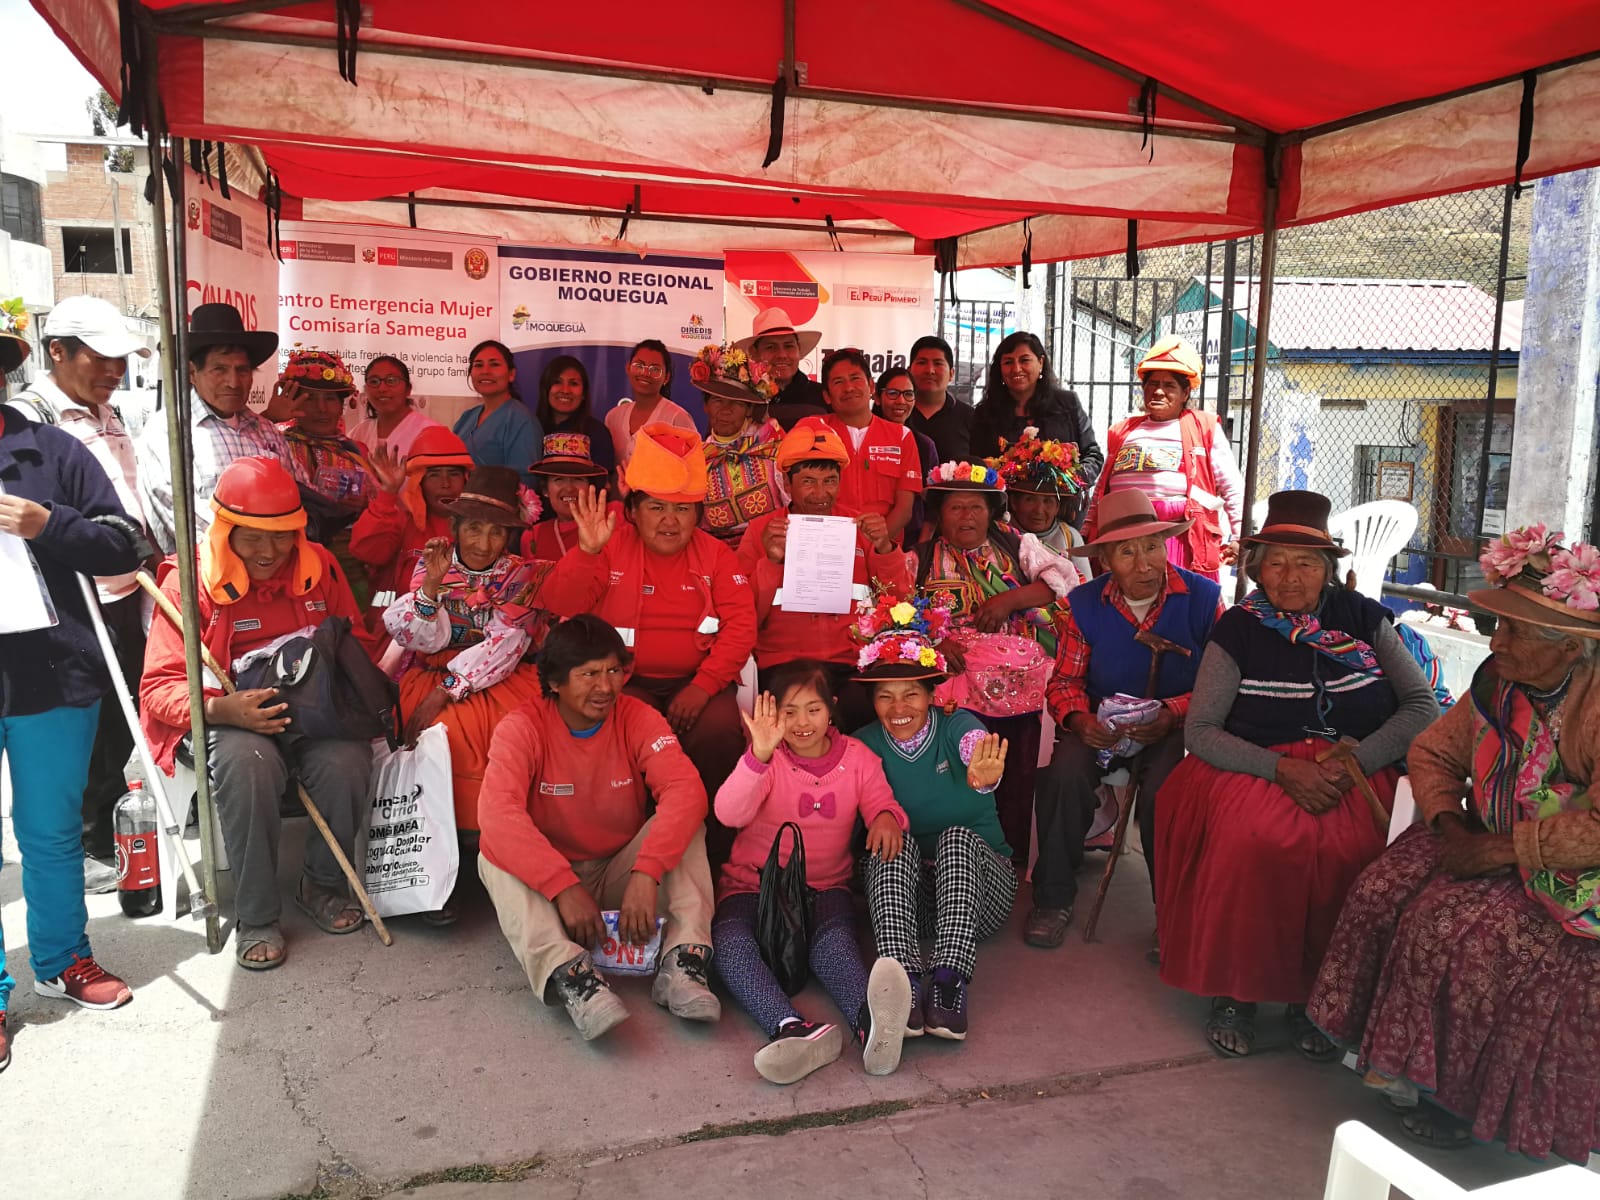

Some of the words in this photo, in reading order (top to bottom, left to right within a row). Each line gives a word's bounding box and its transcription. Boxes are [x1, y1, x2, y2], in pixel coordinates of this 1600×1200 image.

[509, 265, 612, 285] GOBIERNO
[618, 271, 714, 291] REGIONAL
[279, 291, 324, 309] entro
[330, 294, 434, 316] Emergencia
[440, 300, 493, 319] Mujer
[558, 286, 668, 305] MOQUEGUA
[289, 315, 380, 335] Comisaría
[386, 321, 467, 341] Samegua
[680, 326, 712, 335] DIREDIS
[411, 352, 453, 363] violencia
[417, 367, 445, 378] grupo
